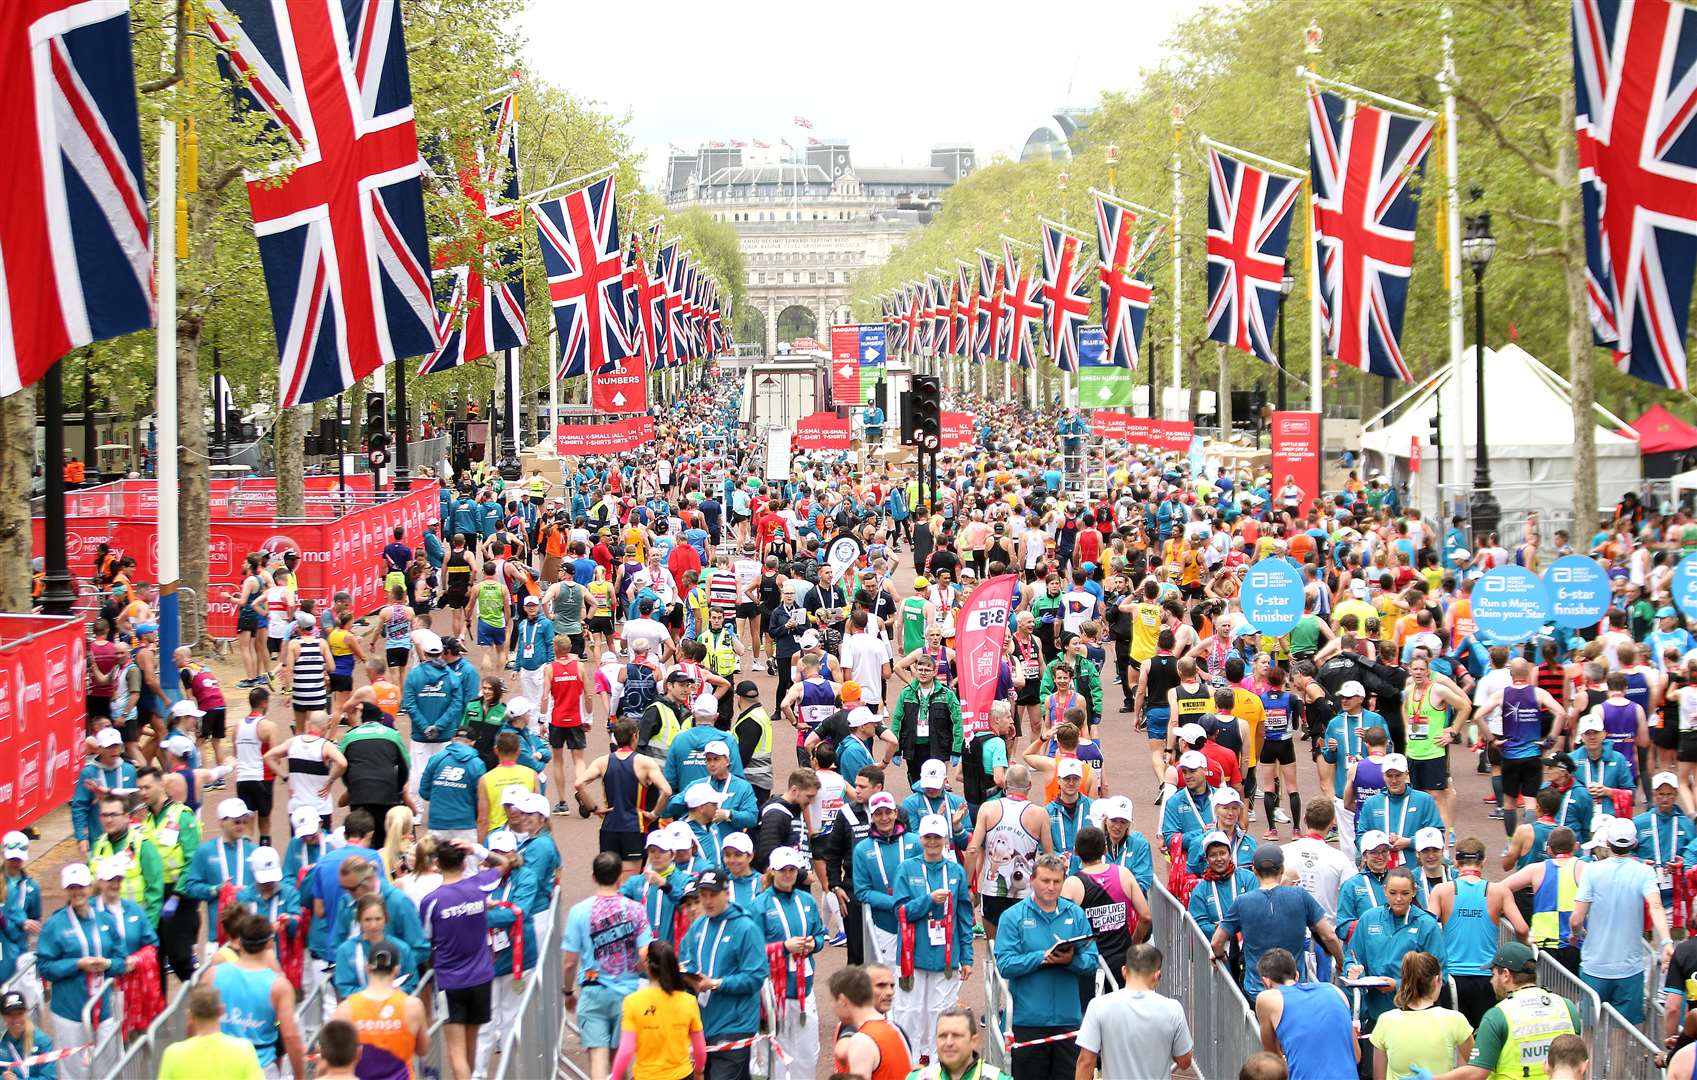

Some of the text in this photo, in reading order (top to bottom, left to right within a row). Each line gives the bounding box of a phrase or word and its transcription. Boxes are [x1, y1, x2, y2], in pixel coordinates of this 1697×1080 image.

[597, 376, 640, 385] NUMBERS
[1256, 593, 1290, 606] 6-star
[1558, 586, 1596, 600] 6-star
[208, 601, 238, 616] oney
[1480, 597, 1500, 607] Run
[1508, 598, 1540, 610] Major,
[1554, 602, 1601, 615] finisher
[1252, 609, 1295, 622] finisher
[1473, 608, 1546, 621] Claim your Star
[441, 901, 484, 919] STORM
[1086, 904, 1124, 917] YOUNG LIVES
[1458, 908, 1483, 918] FELIPE
[1102, 912, 1125, 925] CANCER
[355, 1019, 401, 1031] sense
